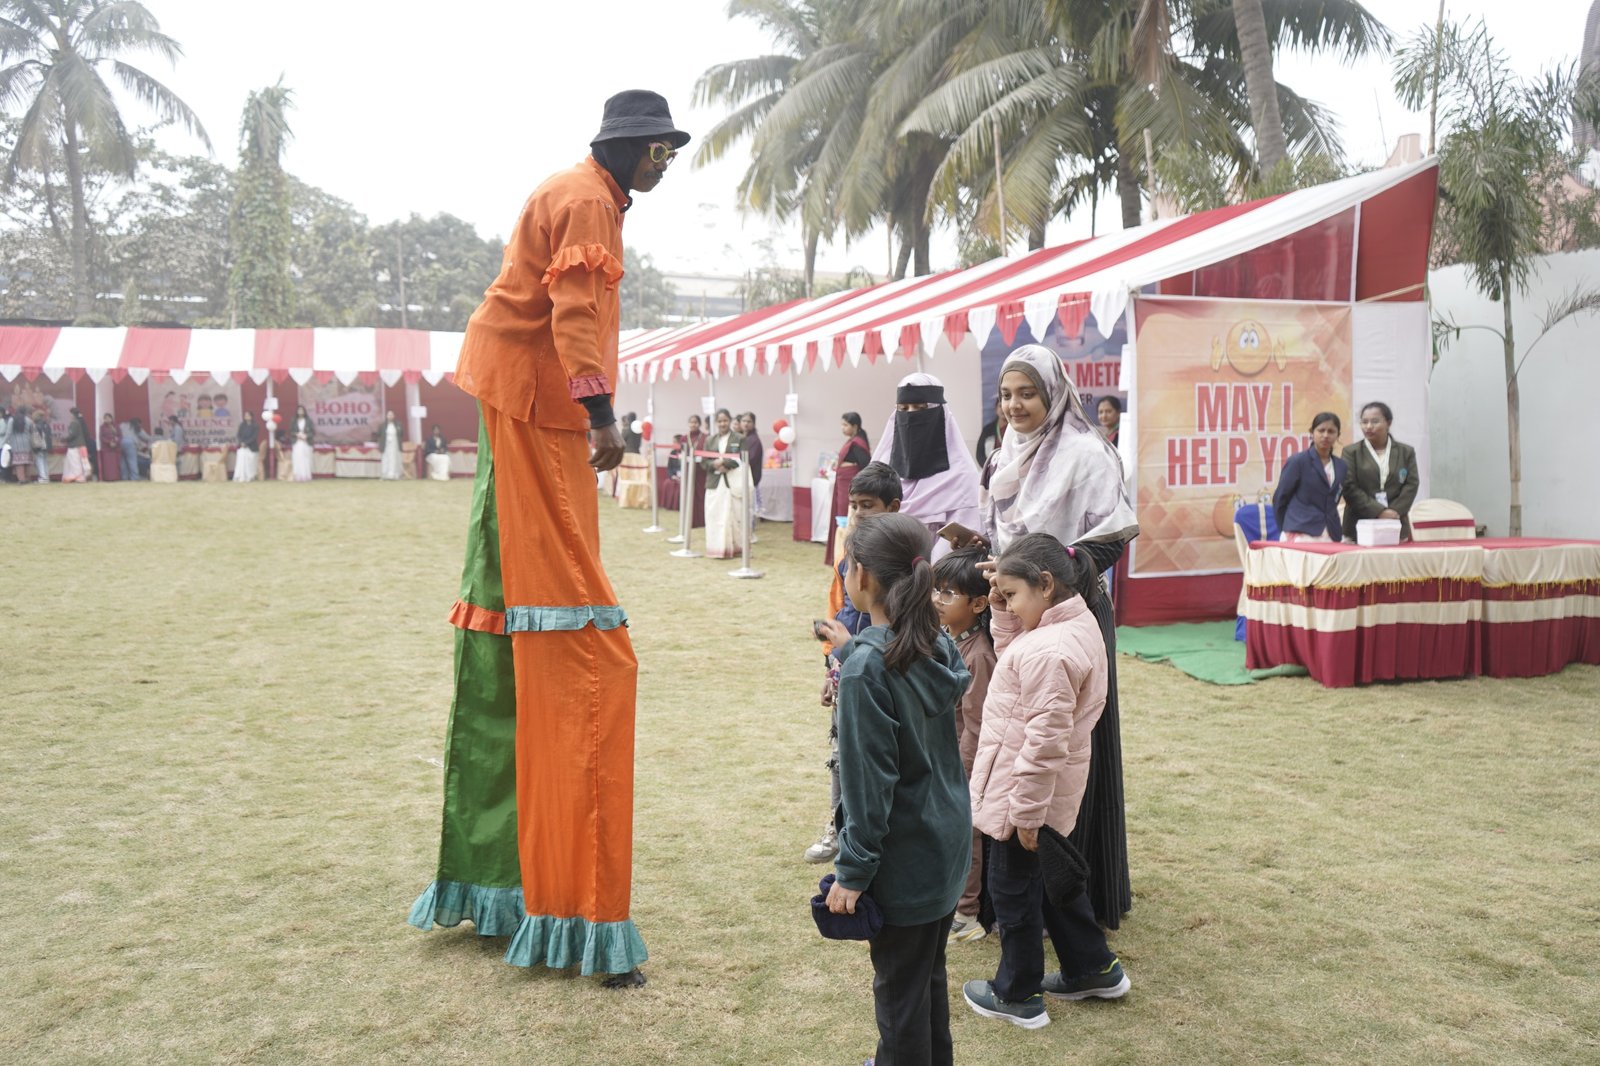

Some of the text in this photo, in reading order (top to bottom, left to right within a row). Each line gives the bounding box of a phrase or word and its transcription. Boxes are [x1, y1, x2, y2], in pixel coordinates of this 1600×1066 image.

[315, 401, 372, 415] BOHO
[317, 417, 368, 426] BAZAAR
[1196, 384, 1292, 433] MAY I
[1167, 436, 1312, 486] HELP YO
